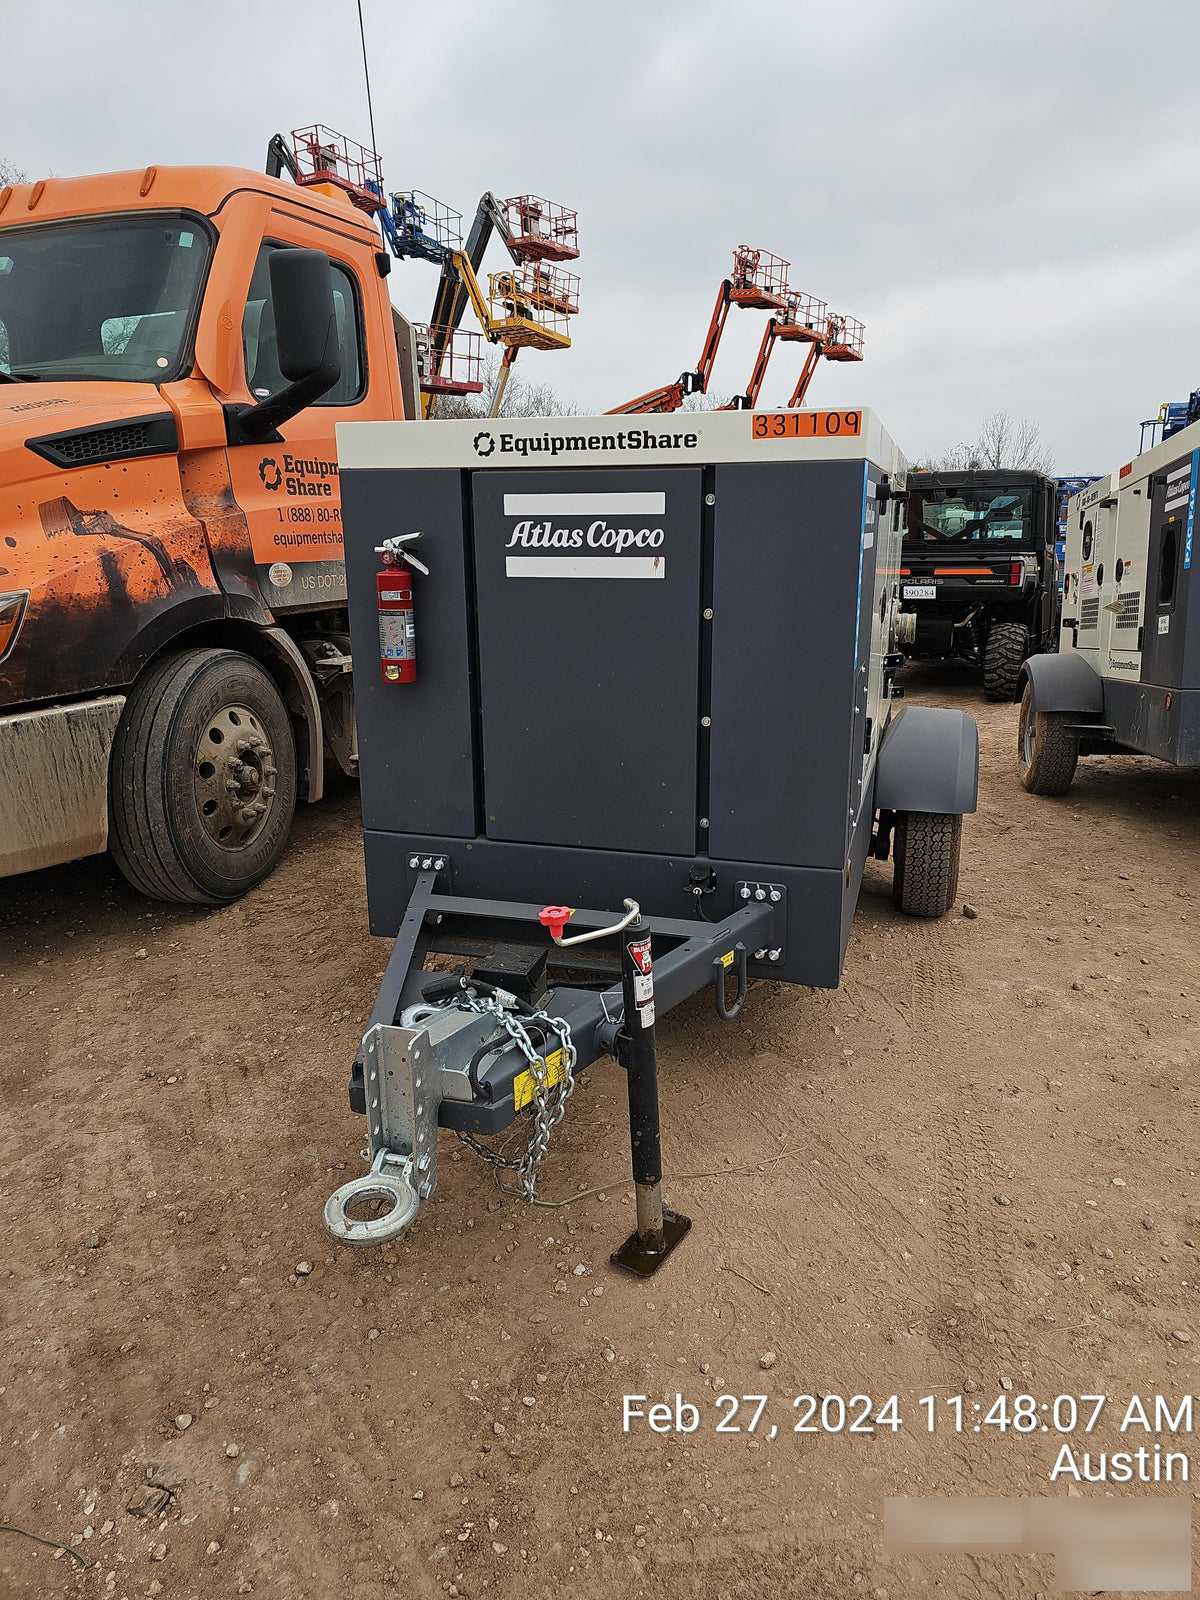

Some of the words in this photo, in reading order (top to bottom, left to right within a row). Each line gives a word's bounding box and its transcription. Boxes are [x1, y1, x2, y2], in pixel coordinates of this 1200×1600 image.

[755, 412, 859, 436] 331109
[500, 431, 698, 456] EquipmentShare
[286, 478, 332, 496] Share
[277, 508, 284, 522] 1
[287, 507, 315, 523] (888)
[273, 530, 343, 548] equipmentsha
[505, 521, 584, 548] Atlas
[586, 521, 665, 554] Copco
[301, 576, 316, 589] US
[317, 574, 336, 588] DOT
[904, 586, 935, 597] 390284
